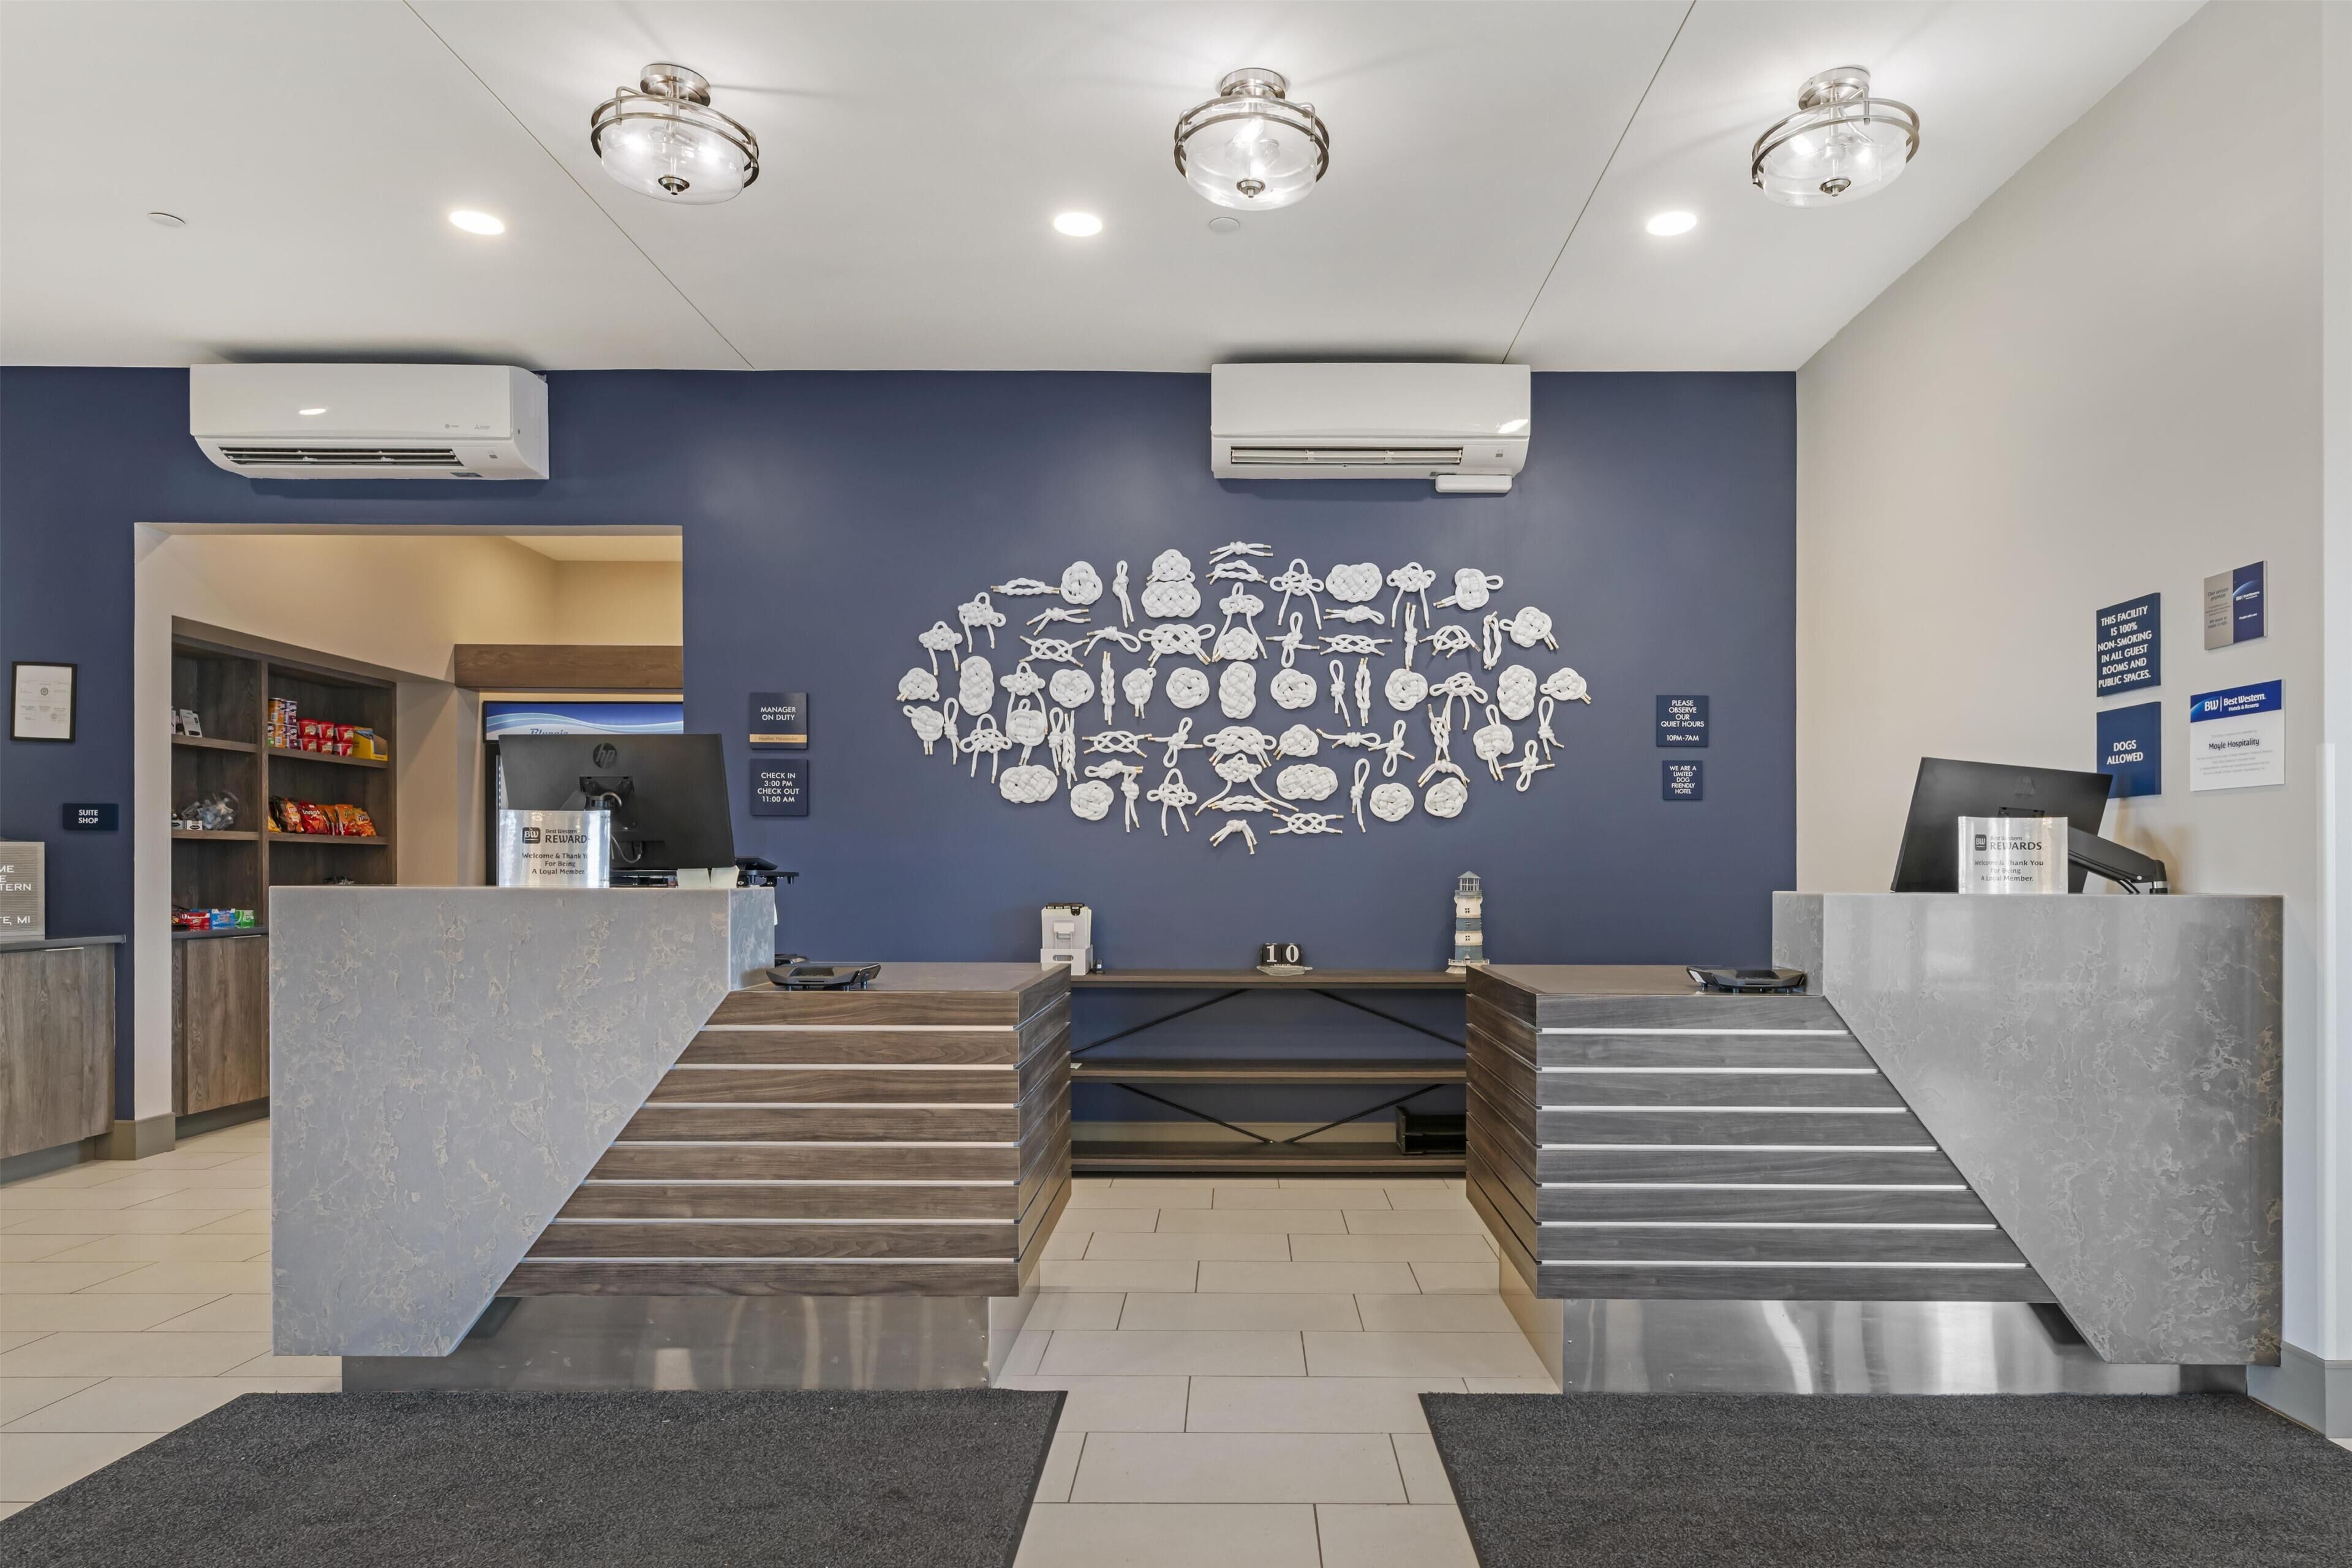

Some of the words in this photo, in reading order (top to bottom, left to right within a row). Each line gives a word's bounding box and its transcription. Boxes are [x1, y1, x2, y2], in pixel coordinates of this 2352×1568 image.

[2101, 615, 2116, 626] THIS
[2117, 605, 2148, 622] FACILITY
[2111, 627, 2117, 636] IS
[2119, 621, 2138, 633] 100%
[2097, 630, 2152, 652] NON-SMOKING
[2101, 654, 2109, 663] IN
[2111, 650, 2123, 661] ALL
[2124, 644, 2148, 657] GUEST
[2102, 662, 2128, 675] ROOMS
[2130, 657, 2147, 669] AND
[2098, 675, 2122, 688] PUBLIC
[2124, 669, 2151, 682] SPACES.
[2204, 699, 2219, 712] BW
[2223, 698, 2237, 706] Best
[2113, 739, 2136, 752] DOGS
[2209, 742, 2226, 751] Moyle
[2227, 737, 2260, 748] Hospitality
[2106, 752, 2144, 765] ALLOWED
[545, 835, 590, 843] REWARD
